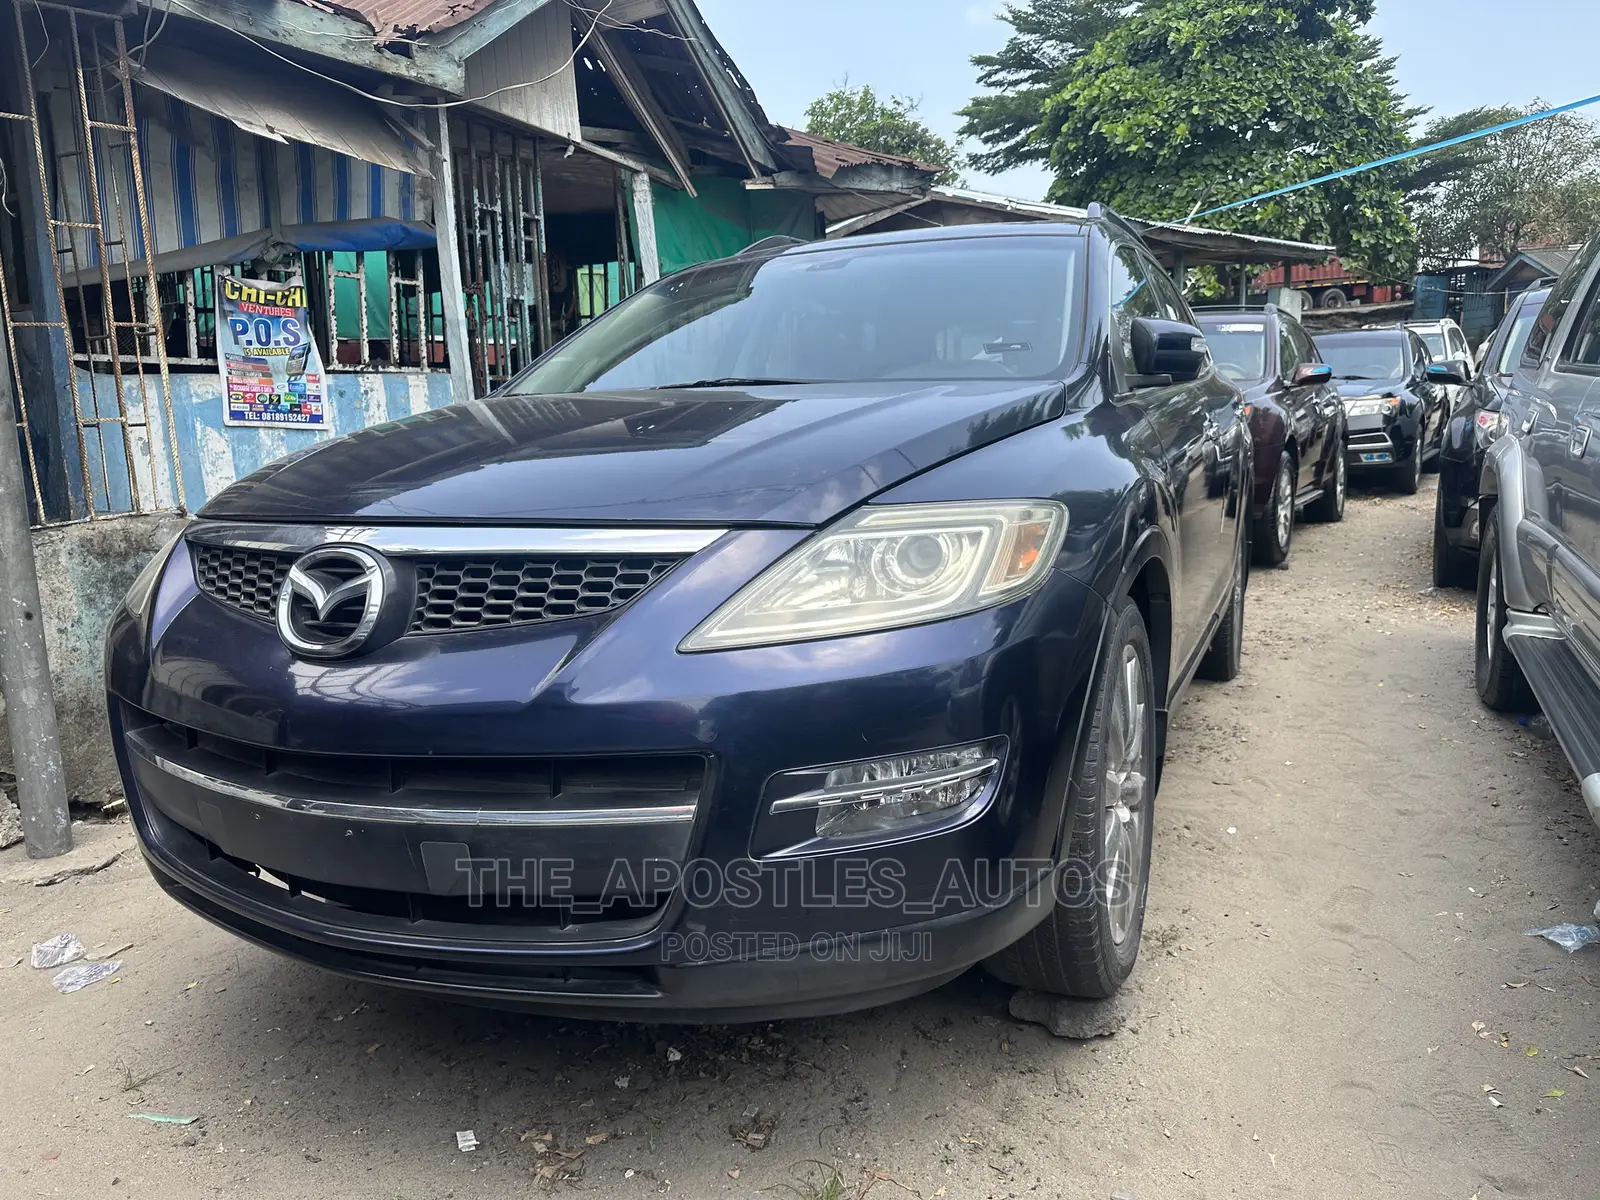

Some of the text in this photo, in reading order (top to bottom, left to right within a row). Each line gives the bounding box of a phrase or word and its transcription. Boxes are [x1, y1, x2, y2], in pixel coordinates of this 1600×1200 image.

[241, 303, 292, 317] VENTURES
[228, 317, 301, 346] P.O.S
[253, 347, 290, 356] AVAILABLE
[244, 411, 310, 422] TEL: 08189152427
